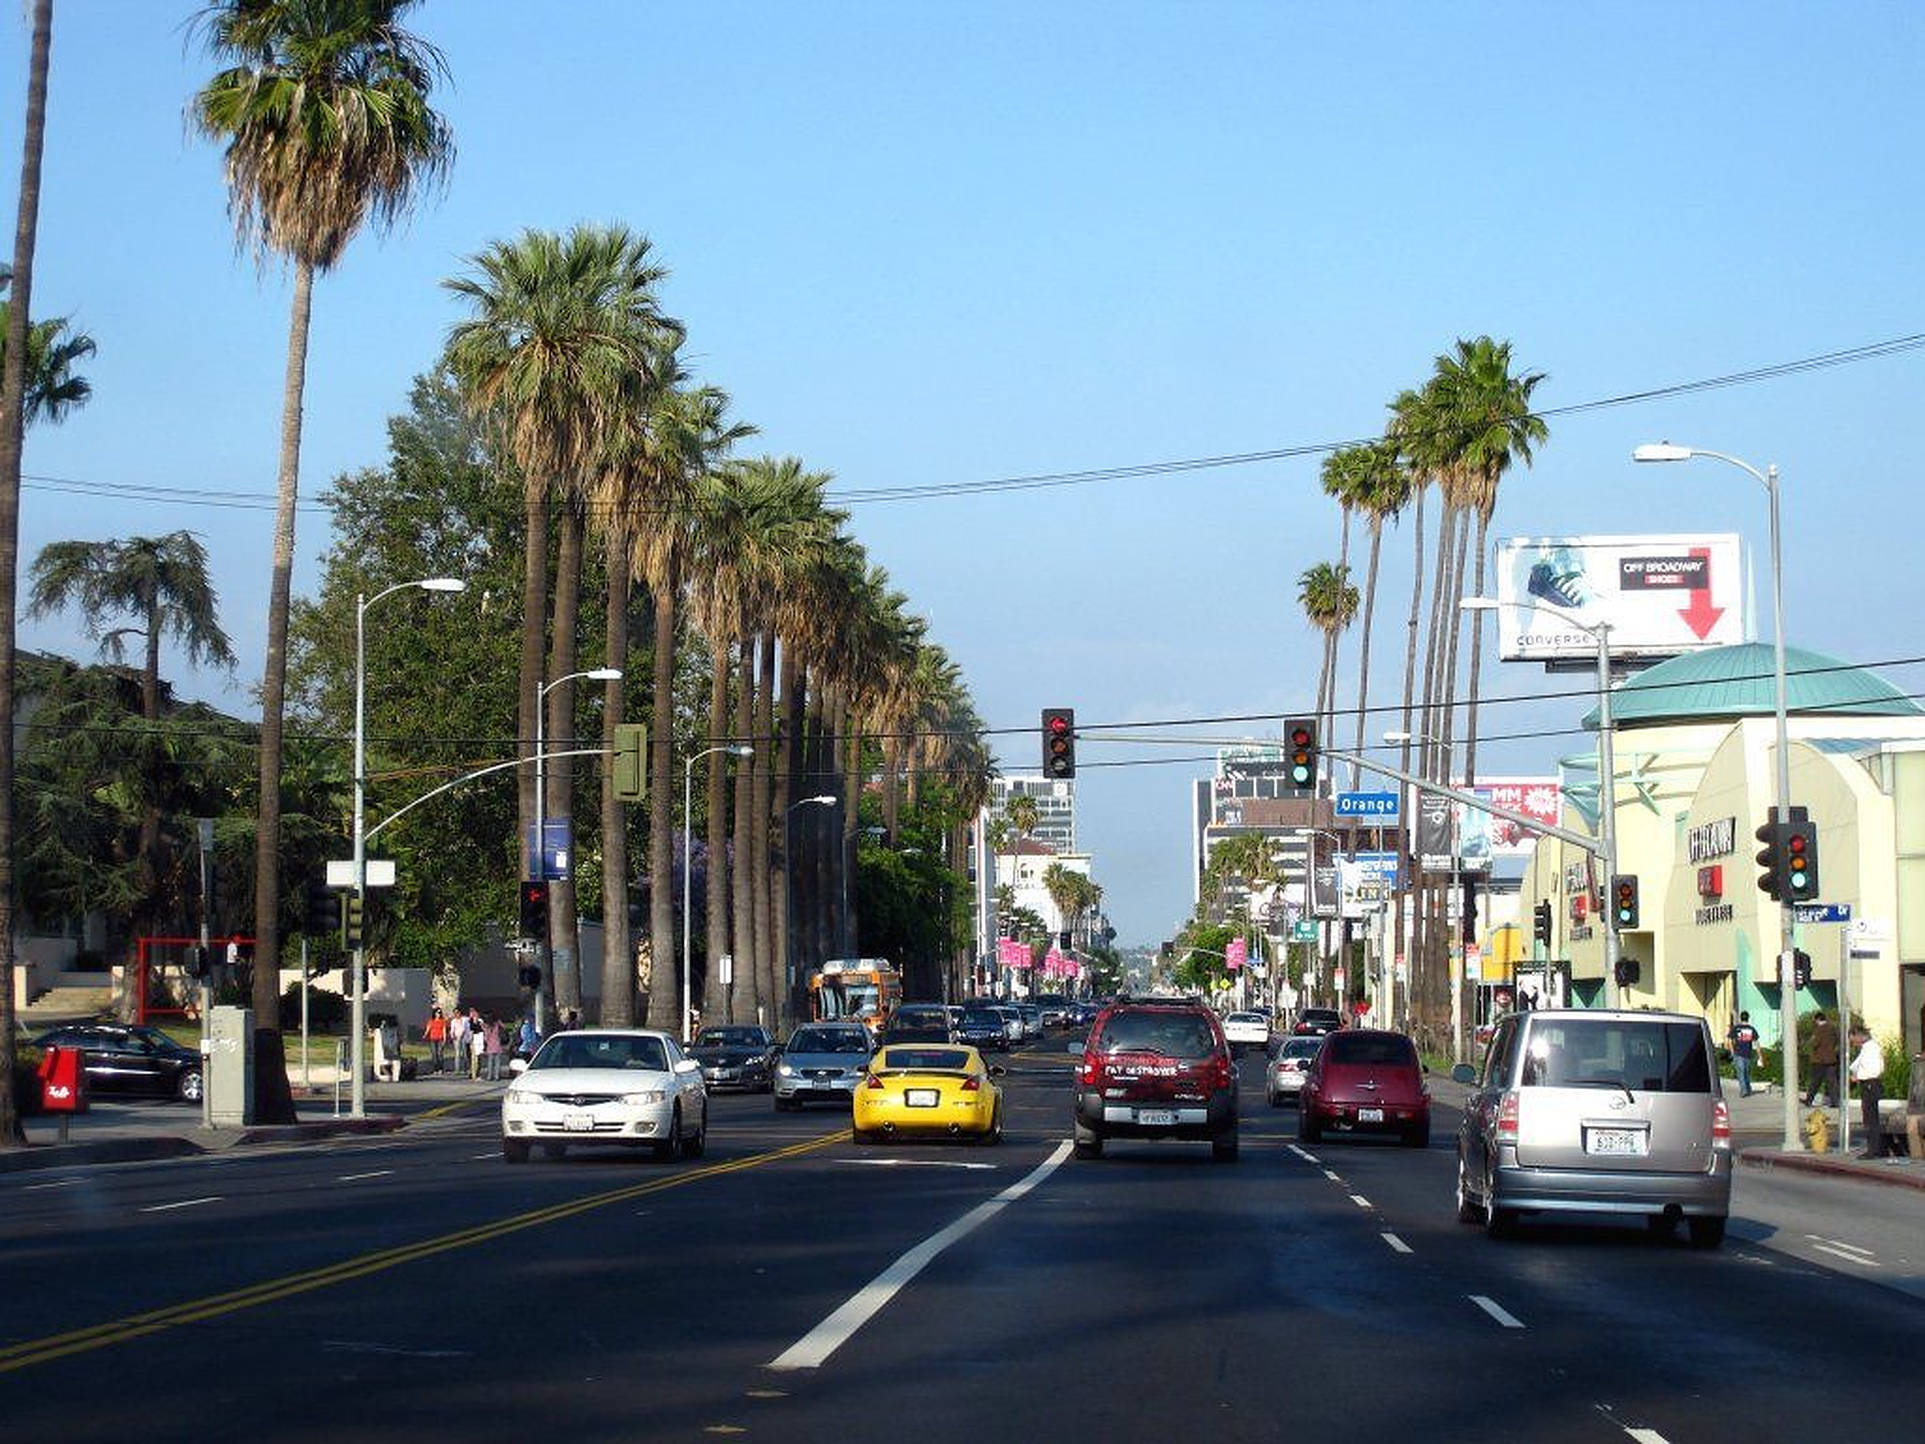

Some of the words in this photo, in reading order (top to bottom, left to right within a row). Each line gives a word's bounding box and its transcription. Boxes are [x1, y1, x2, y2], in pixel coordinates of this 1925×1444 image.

[1623, 563, 1644, 573] OFF
[1646, 561, 1703, 573] BROADWAY
[1341, 798, 1394, 813] Orange
